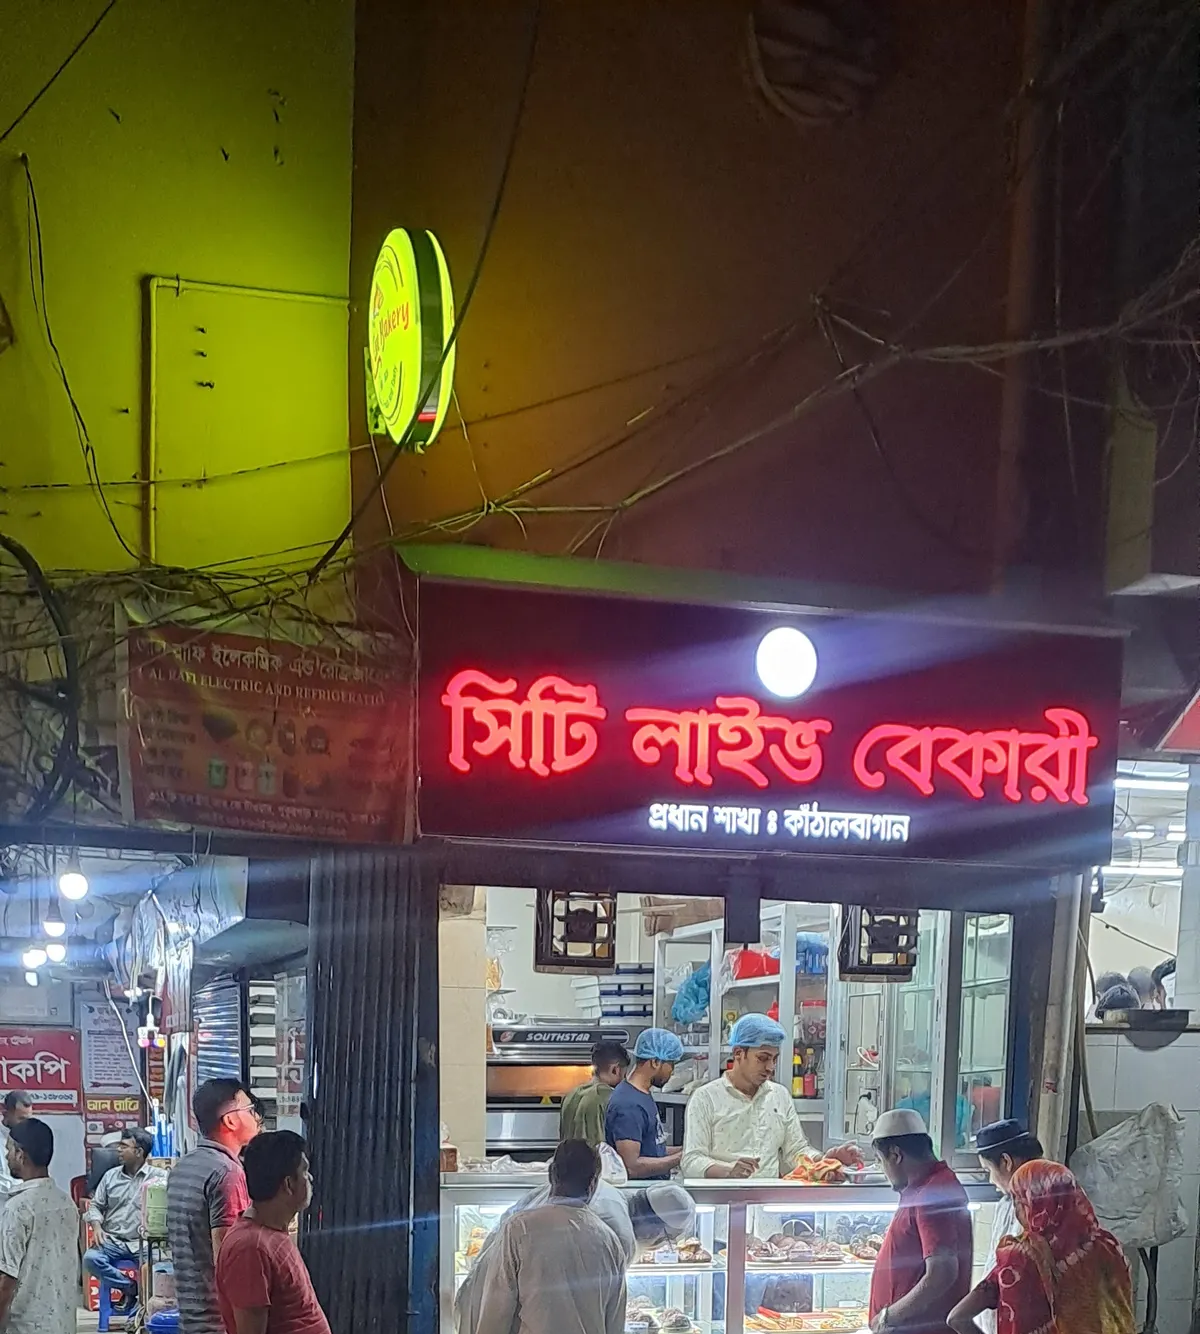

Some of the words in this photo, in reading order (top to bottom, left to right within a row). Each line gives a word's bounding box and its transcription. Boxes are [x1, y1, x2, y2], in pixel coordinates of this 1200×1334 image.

[201, 674, 263, 694] ELECTRIC
[265, 681, 292, 697] AND
[295, 686, 385, 706] REFRIGERATIO
[441, 669, 606, 777] সিটি
[624, 696, 832, 787] লাইভ
[853, 708, 1098, 804] বেকারী
[648, 802, 708, 833] প্রধান
[712, 805, 761, 836] শাখা
[783, 800, 911, 842] কাঁঠালবাগান
[526, 1032, 591, 1042] SOUTHSTAR
